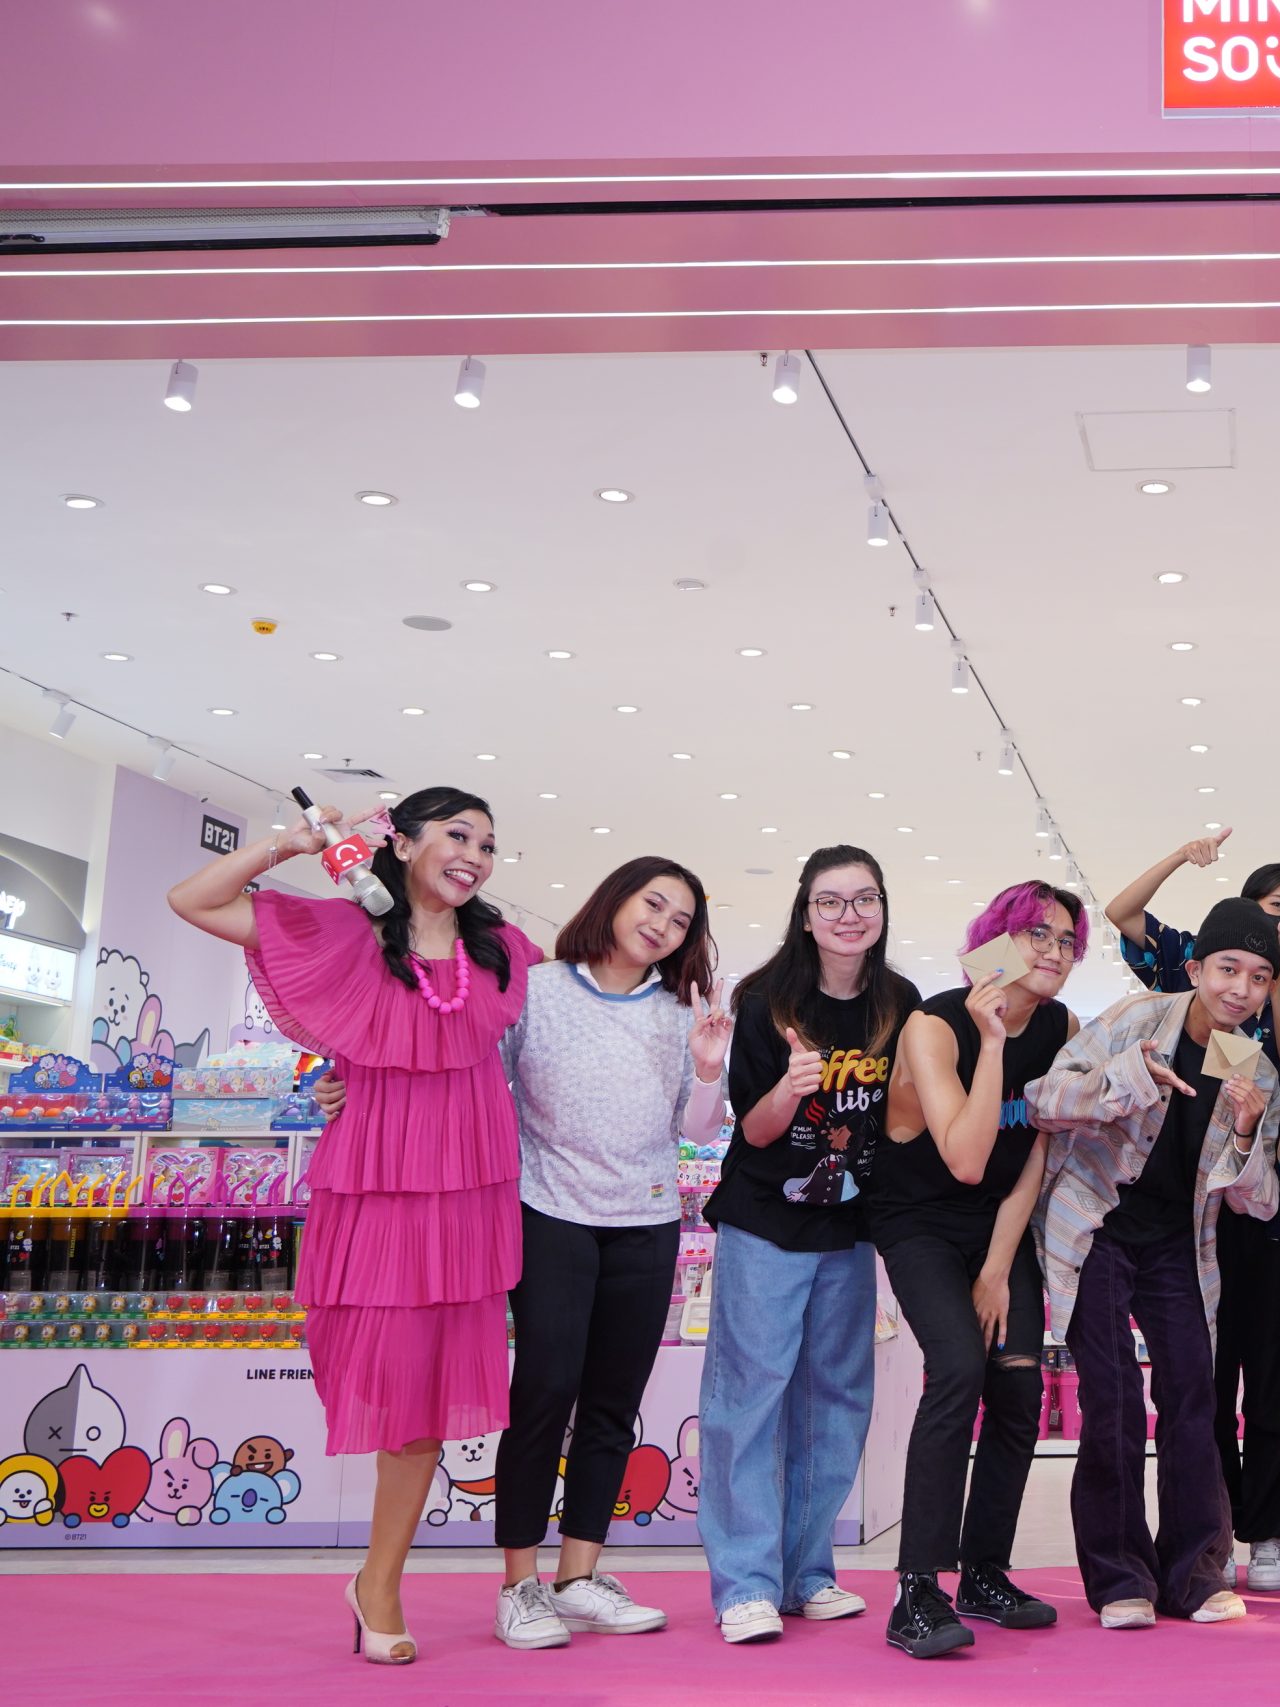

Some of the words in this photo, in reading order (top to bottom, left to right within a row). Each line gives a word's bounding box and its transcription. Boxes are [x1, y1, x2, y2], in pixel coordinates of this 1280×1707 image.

[204, 822, 235, 852] BT21
[247, 1369, 276, 1380] LINE
[279, 1369, 315, 1380] FRIEN
